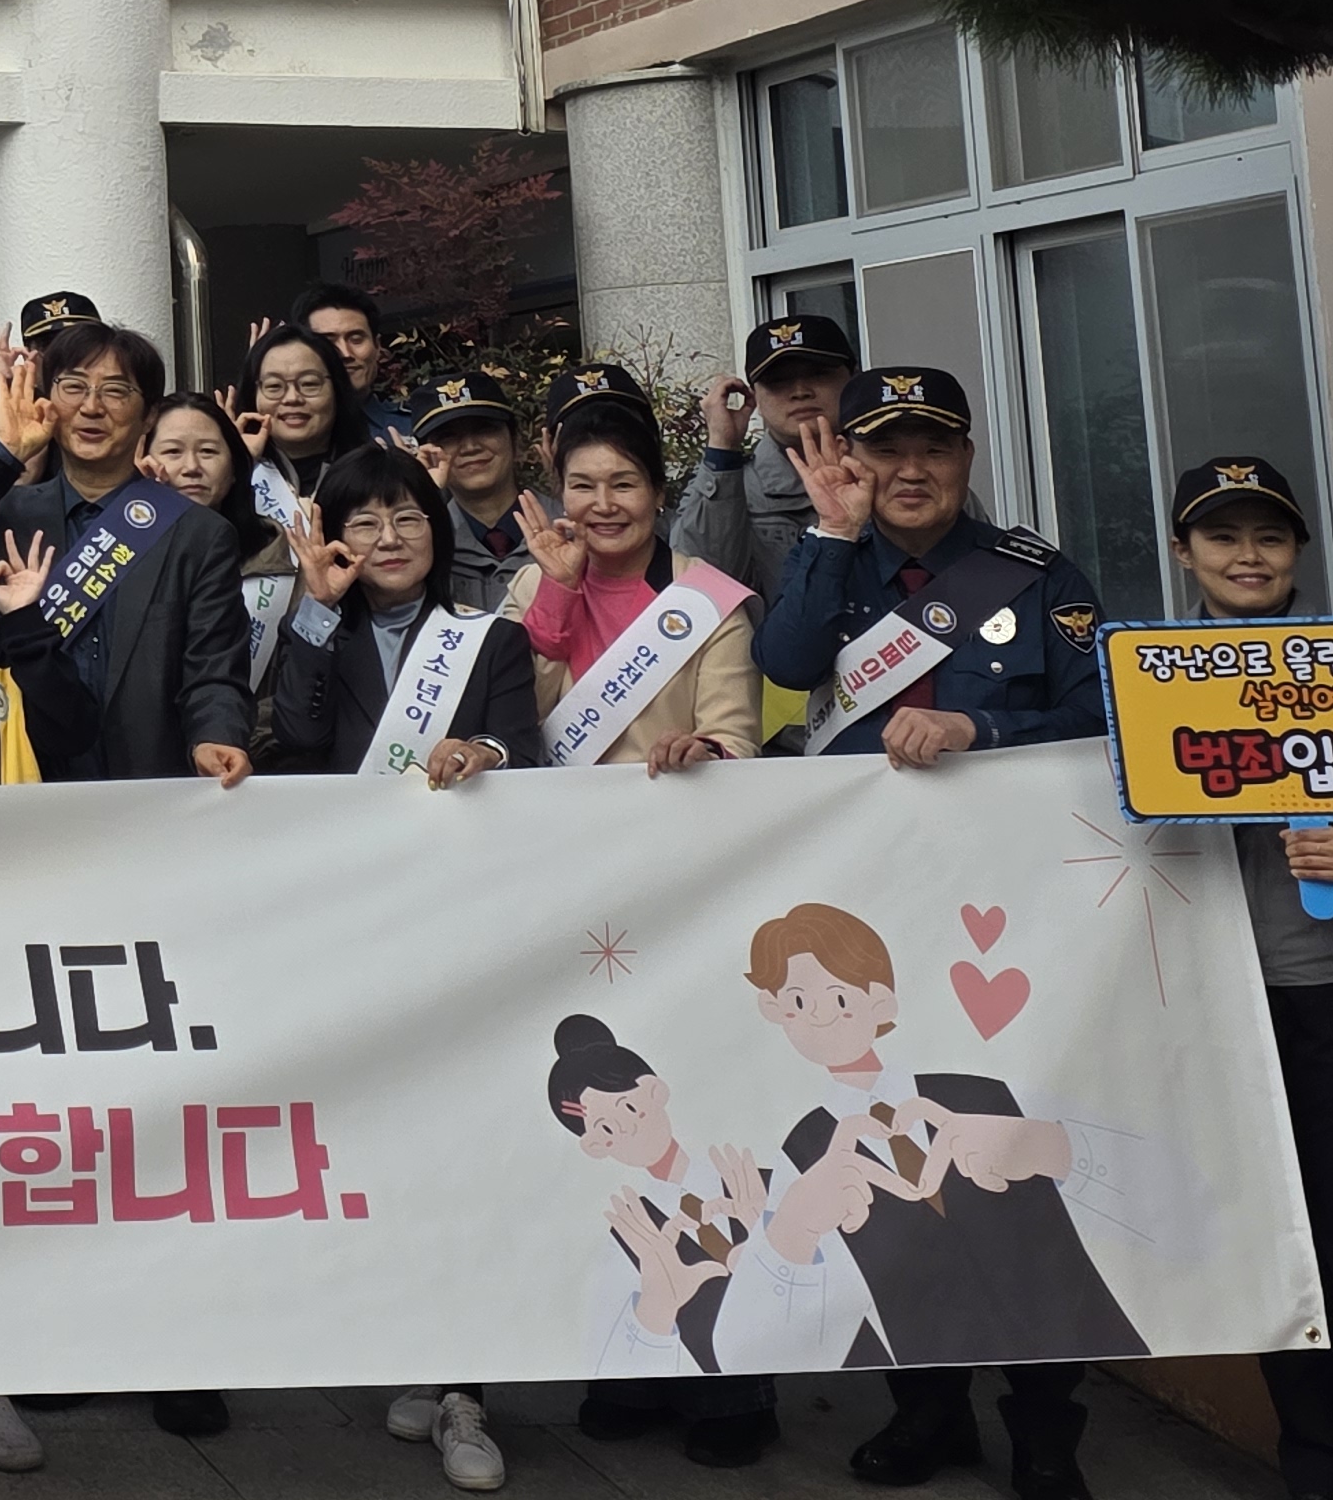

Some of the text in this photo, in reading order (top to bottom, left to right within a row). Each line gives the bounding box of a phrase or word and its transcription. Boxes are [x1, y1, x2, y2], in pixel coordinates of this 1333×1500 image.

[66, 527, 116, 584] 게임이
[83, 543, 135, 599] 청소년
[843, 629, 922, 695] 딥페이크
[1136, 643, 1275, 682] 장난으로
[383, 628, 464, 775] 청소년이 안
[547, 645, 660, 766] 안전한 우리도
